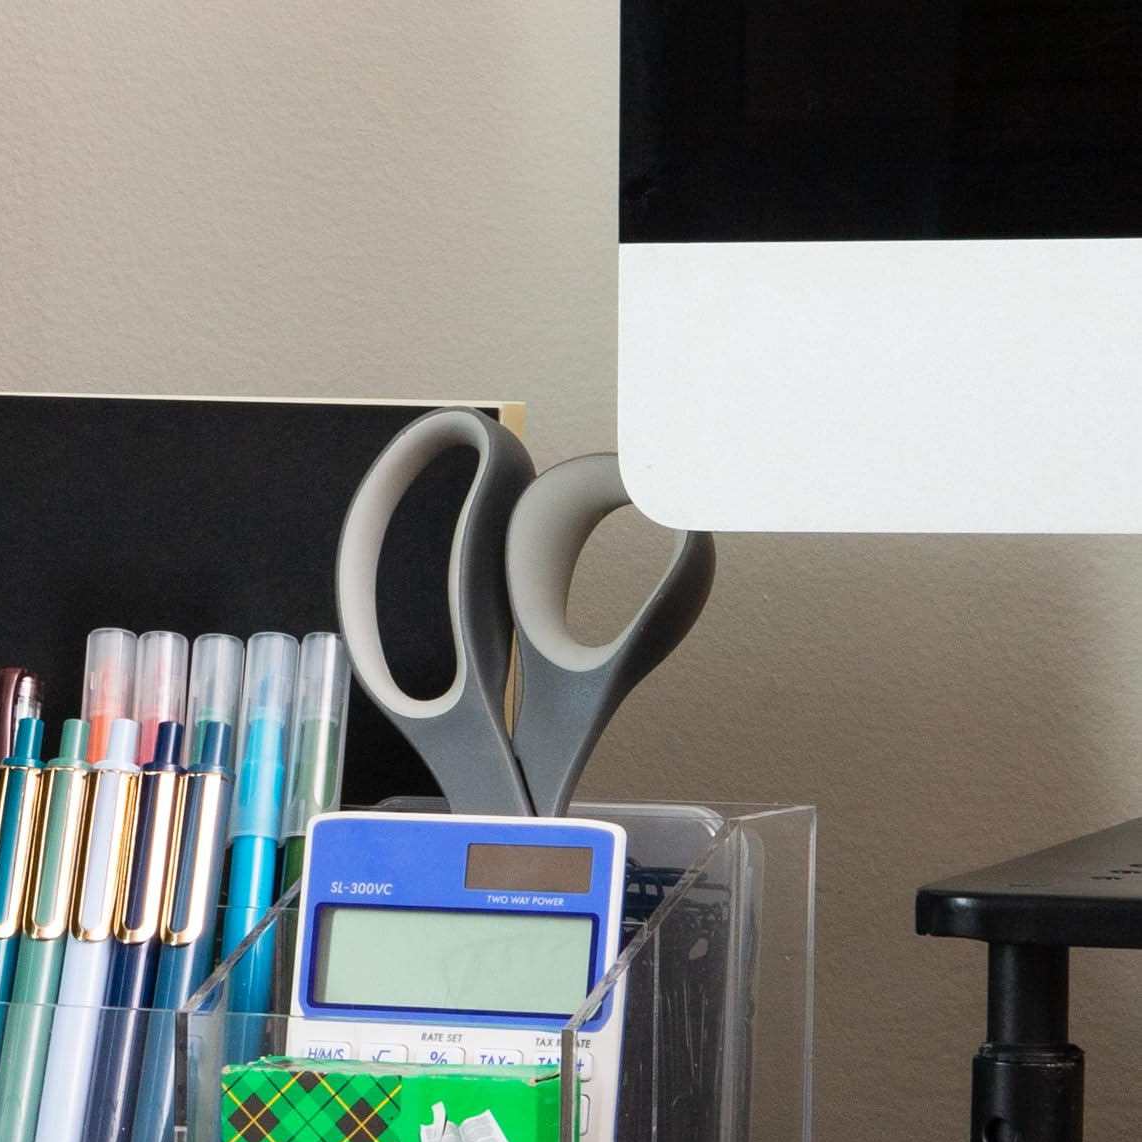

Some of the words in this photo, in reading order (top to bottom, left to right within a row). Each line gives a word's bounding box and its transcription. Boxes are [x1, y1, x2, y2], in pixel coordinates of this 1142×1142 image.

[330, 881, 394, 896] SL-300VC
[487, 895, 509, 904] TWO
[510, 896, 531, 905] WAY
[532, 896, 564, 906] POWER
[421, 1032, 443, 1042] RATE
[446, 1034, 463, 1043] SET
[535, 1037, 553, 1047] TAX
